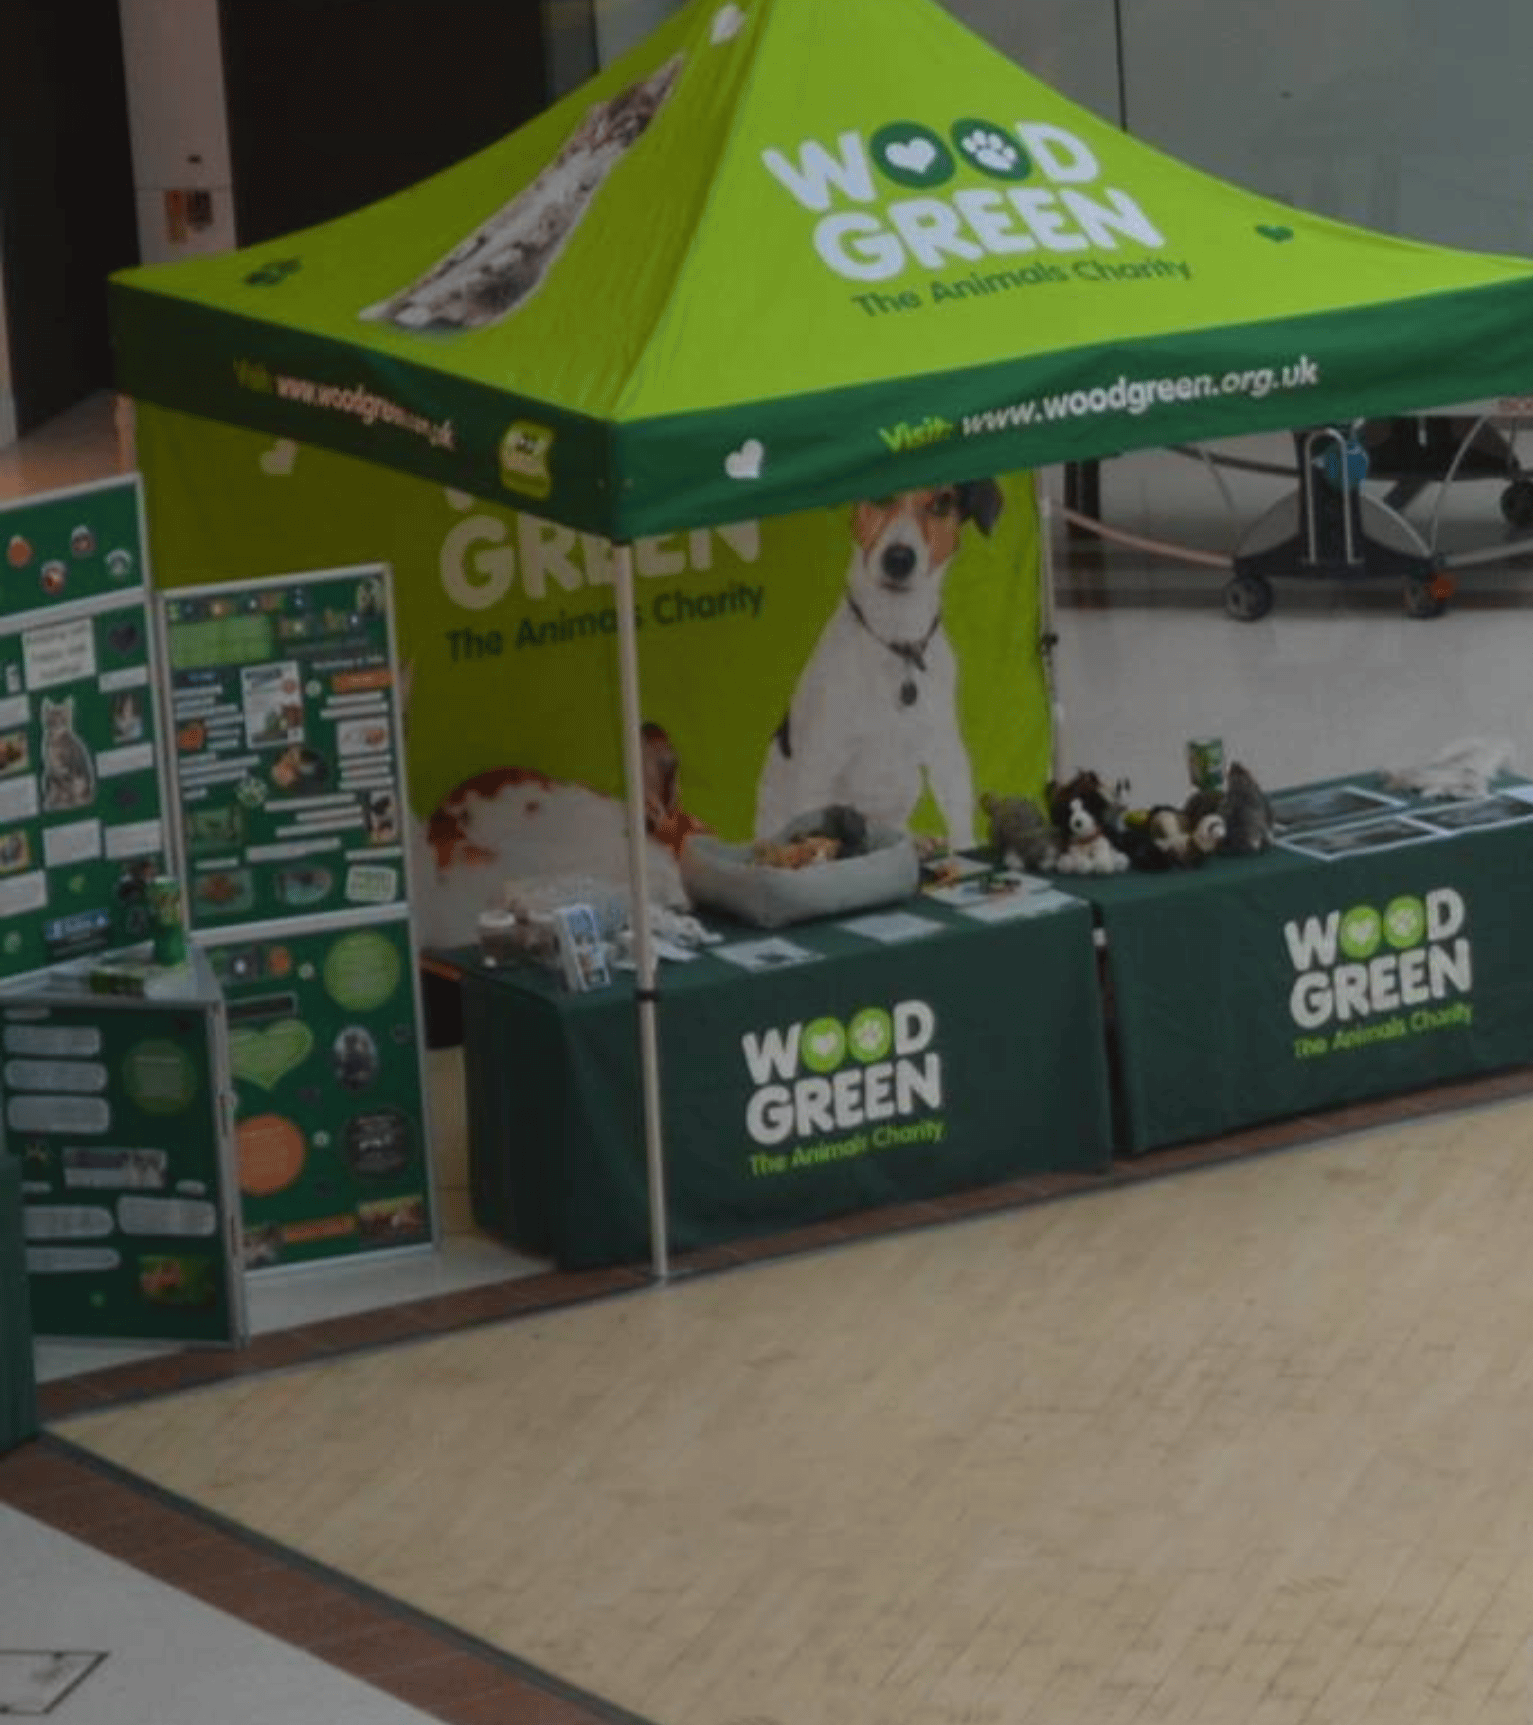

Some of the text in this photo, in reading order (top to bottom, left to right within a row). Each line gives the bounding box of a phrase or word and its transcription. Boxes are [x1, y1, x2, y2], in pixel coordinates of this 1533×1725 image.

[762, 118, 1098, 212] WOOD
[813, 188, 1165, 281] GREEN
[852, 256, 1192, 317] The Animals Charity
[962, 356, 1319, 437] www.woodgreen.org.uk
[445, 584, 764, 661] The Animas Charity
[1284, 887, 1465, 970] WOOD
[1290, 937, 1472, 1029] GREEN
[742, 1000, 935, 1084] WOOD
[746, 1052, 942, 1144] GREEN
